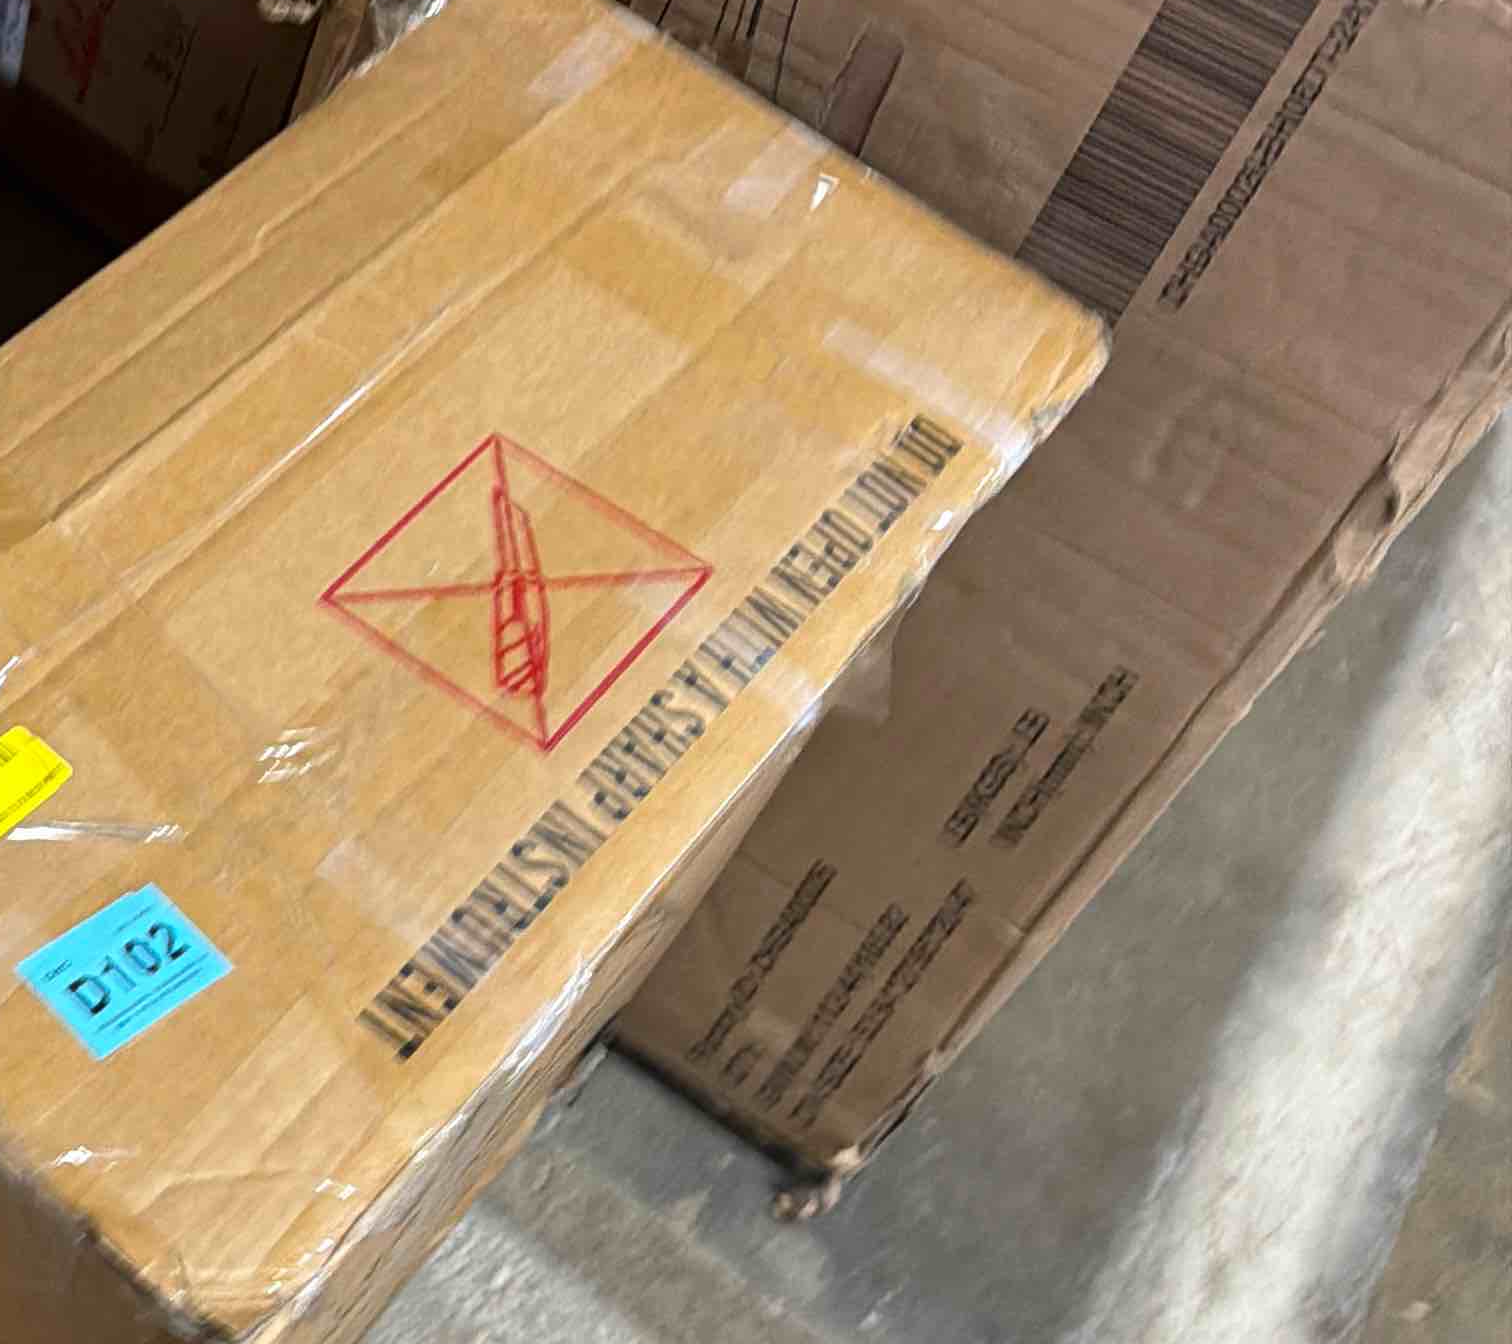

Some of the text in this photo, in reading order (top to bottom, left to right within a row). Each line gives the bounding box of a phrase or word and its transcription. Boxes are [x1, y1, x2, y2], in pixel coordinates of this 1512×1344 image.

[354, 412, 963, 1065] DO NOT OPEN WITH A SHARP INSTRUMENT
[64, 921, 190, 1018] D102
